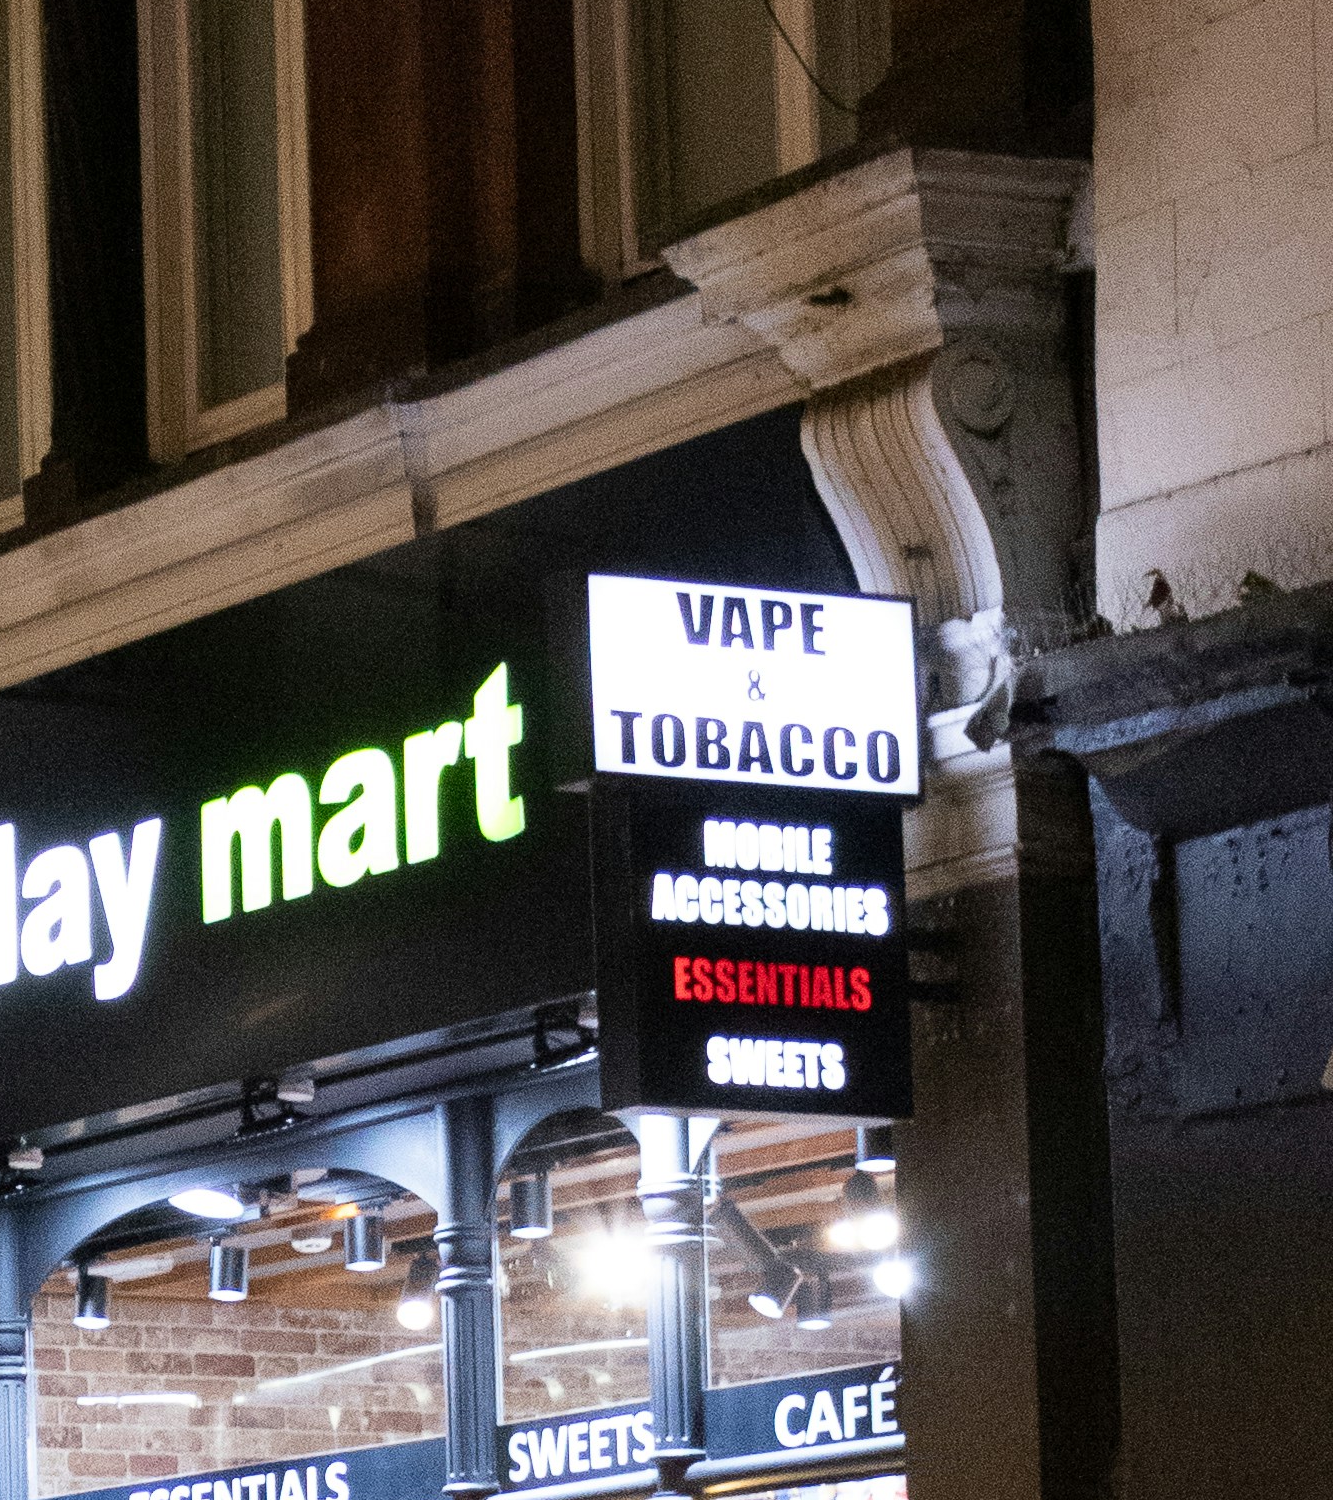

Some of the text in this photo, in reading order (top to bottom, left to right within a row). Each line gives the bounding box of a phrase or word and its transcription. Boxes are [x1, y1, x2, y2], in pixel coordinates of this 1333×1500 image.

[676, 591, 826, 656] VAPE
[747, 669, 766, 701] &
[610, 709, 901, 784] TOBACCO
[200, 661, 526, 925] mart
[703, 819, 833, 876] MOBILE
[651, 873, 890, 937] ACCESSORIES
[673, 956, 873, 1012] ESSENTIALS
[706, 1035, 847, 1090] SWEETS
[774, 1365, 899, 1448] CAFÉ
[507, 1410, 655, 1484] SWEETS
